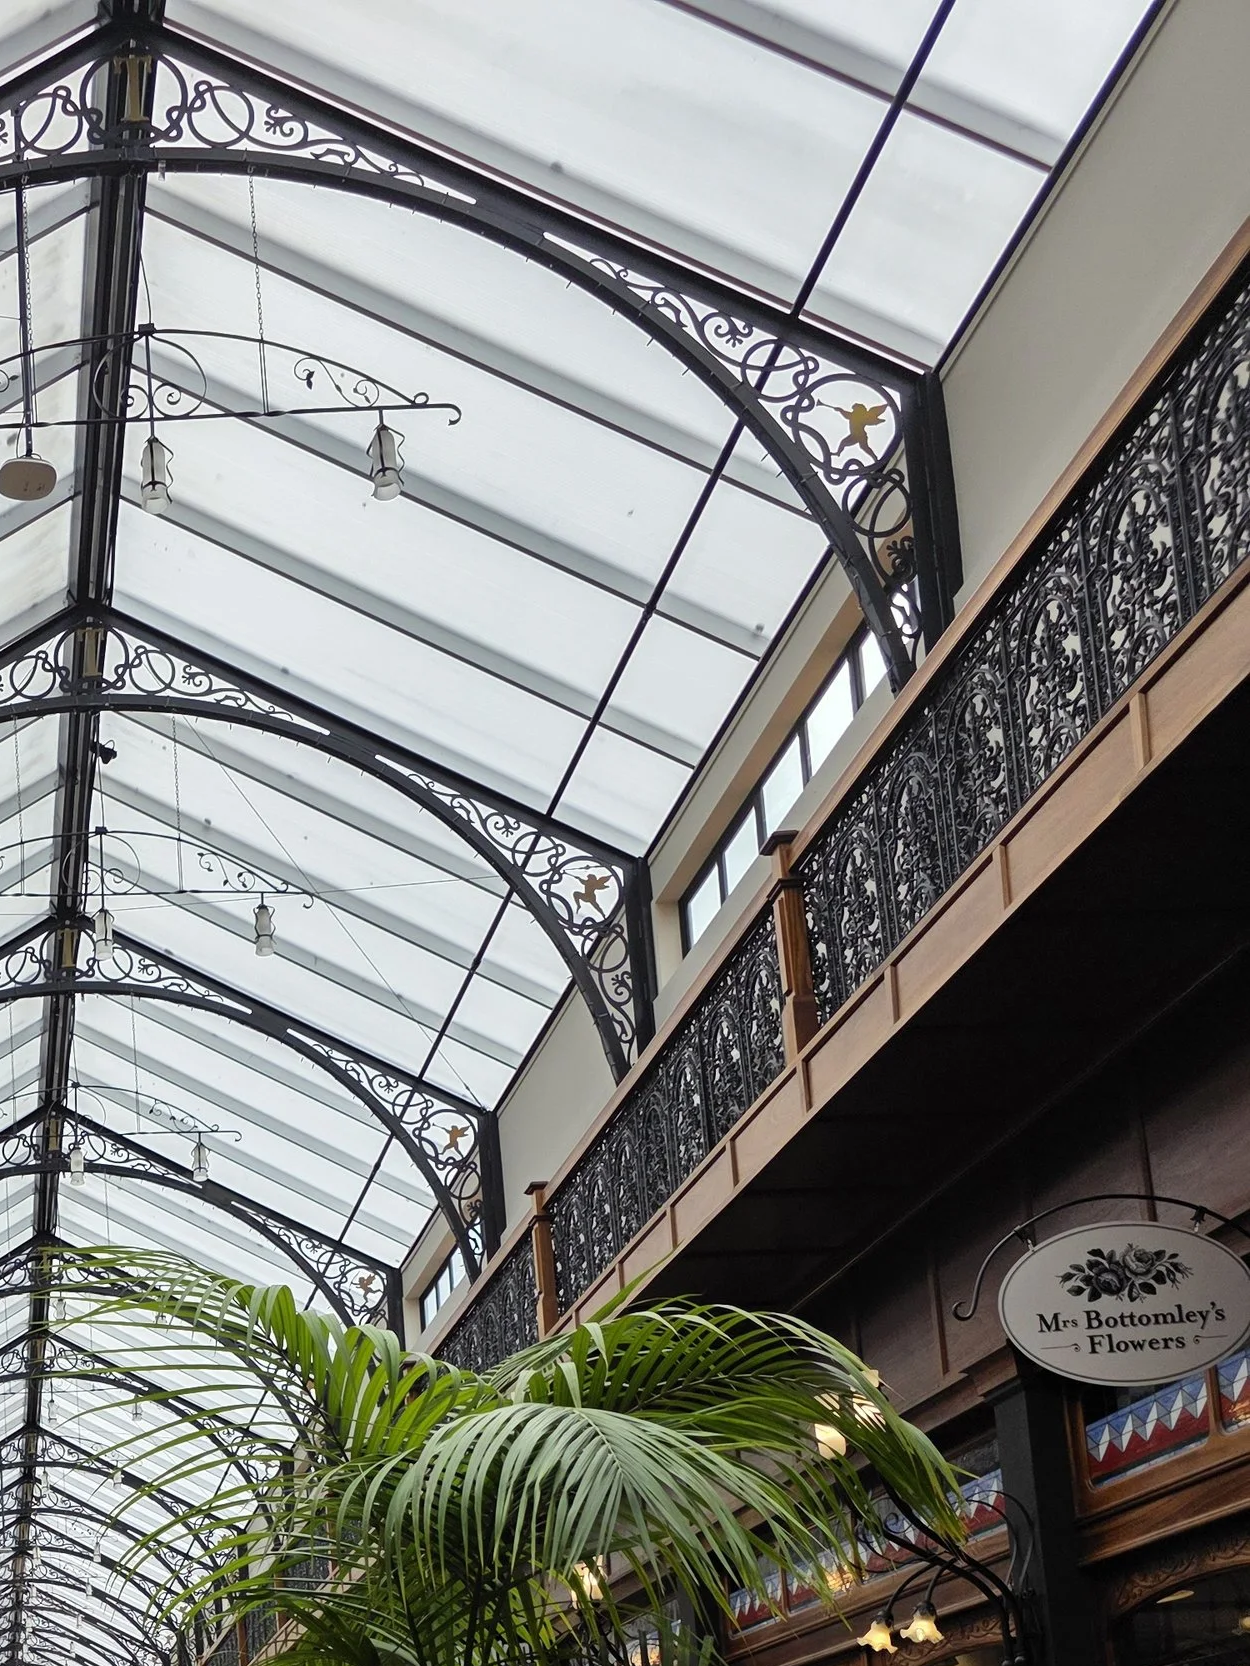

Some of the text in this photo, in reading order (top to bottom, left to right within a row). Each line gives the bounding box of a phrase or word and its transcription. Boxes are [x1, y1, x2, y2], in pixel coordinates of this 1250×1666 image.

[1037, 1302, 1226, 1334] Mrs Bottomley's
[1087, 1333, 1187, 1355] Flowers
